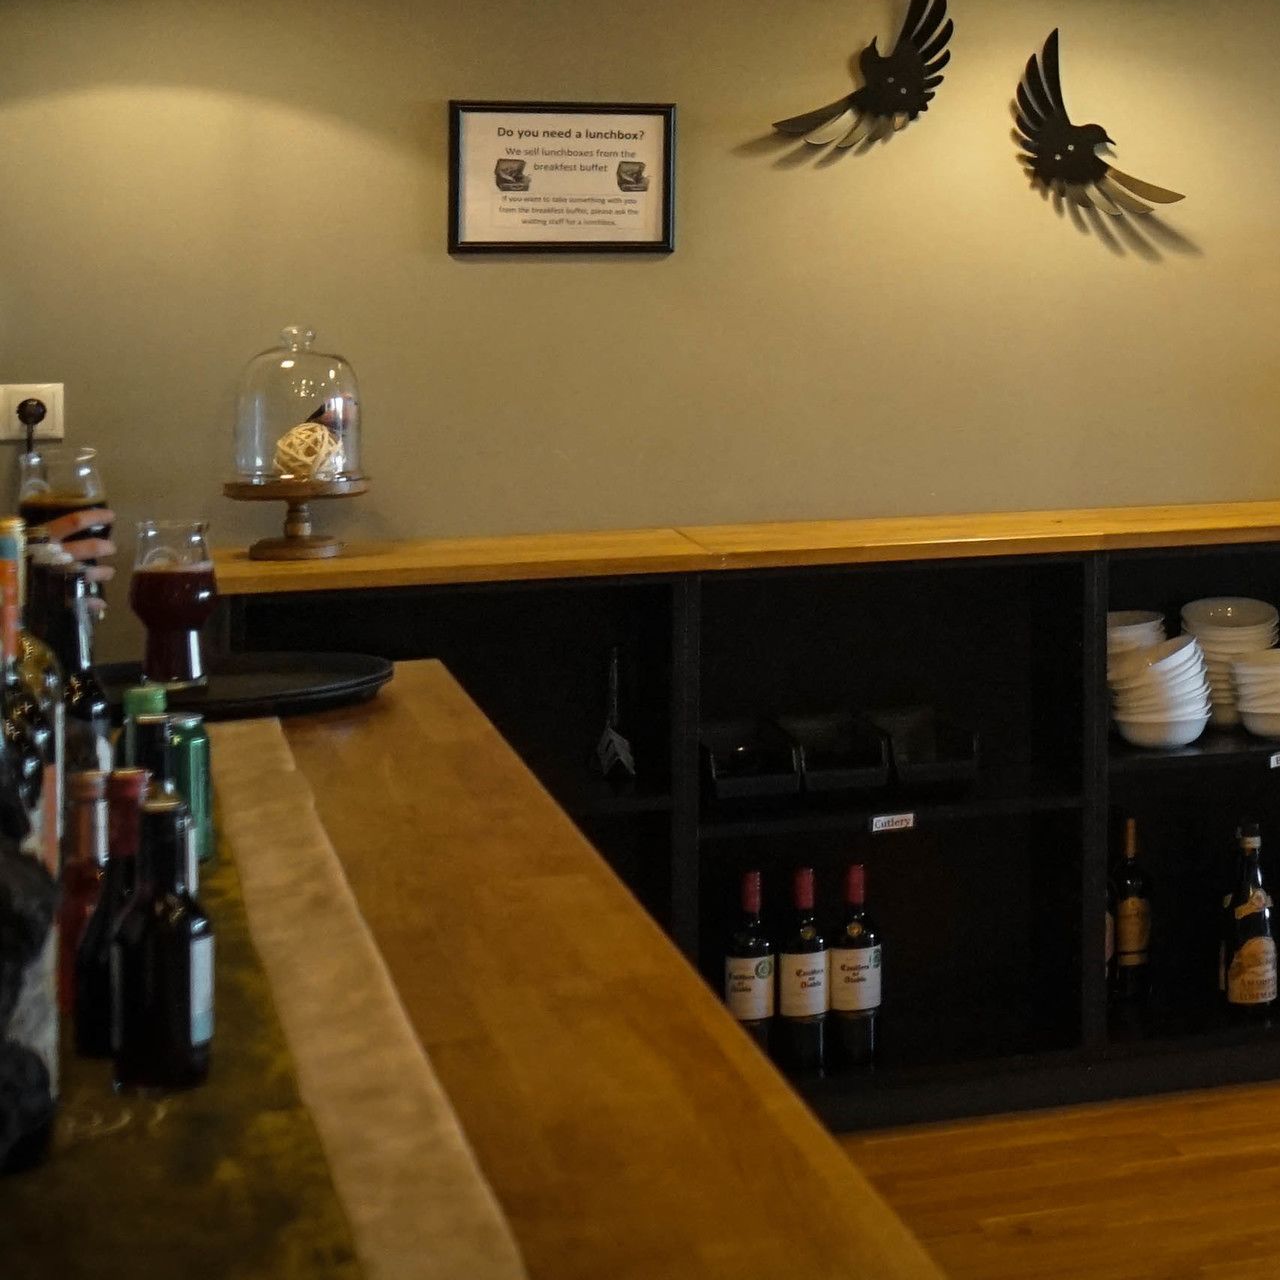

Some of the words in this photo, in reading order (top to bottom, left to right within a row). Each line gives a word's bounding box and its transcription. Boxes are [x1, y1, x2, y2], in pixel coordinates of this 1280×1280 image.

[497, 127, 514, 137] Do
[518, 130, 539, 140] you
[542, 129, 572, 138] need
[585, 129, 644, 140] lunchbox?
[505, 147, 522, 156] We
[541, 148, 594, 157] lunchboxes
[596, 149, 618, 158] from
[620, 150, 636, 158] the
[579, 163, 608, 172] buffet
[874, 816, 911, 828] Cutlery
